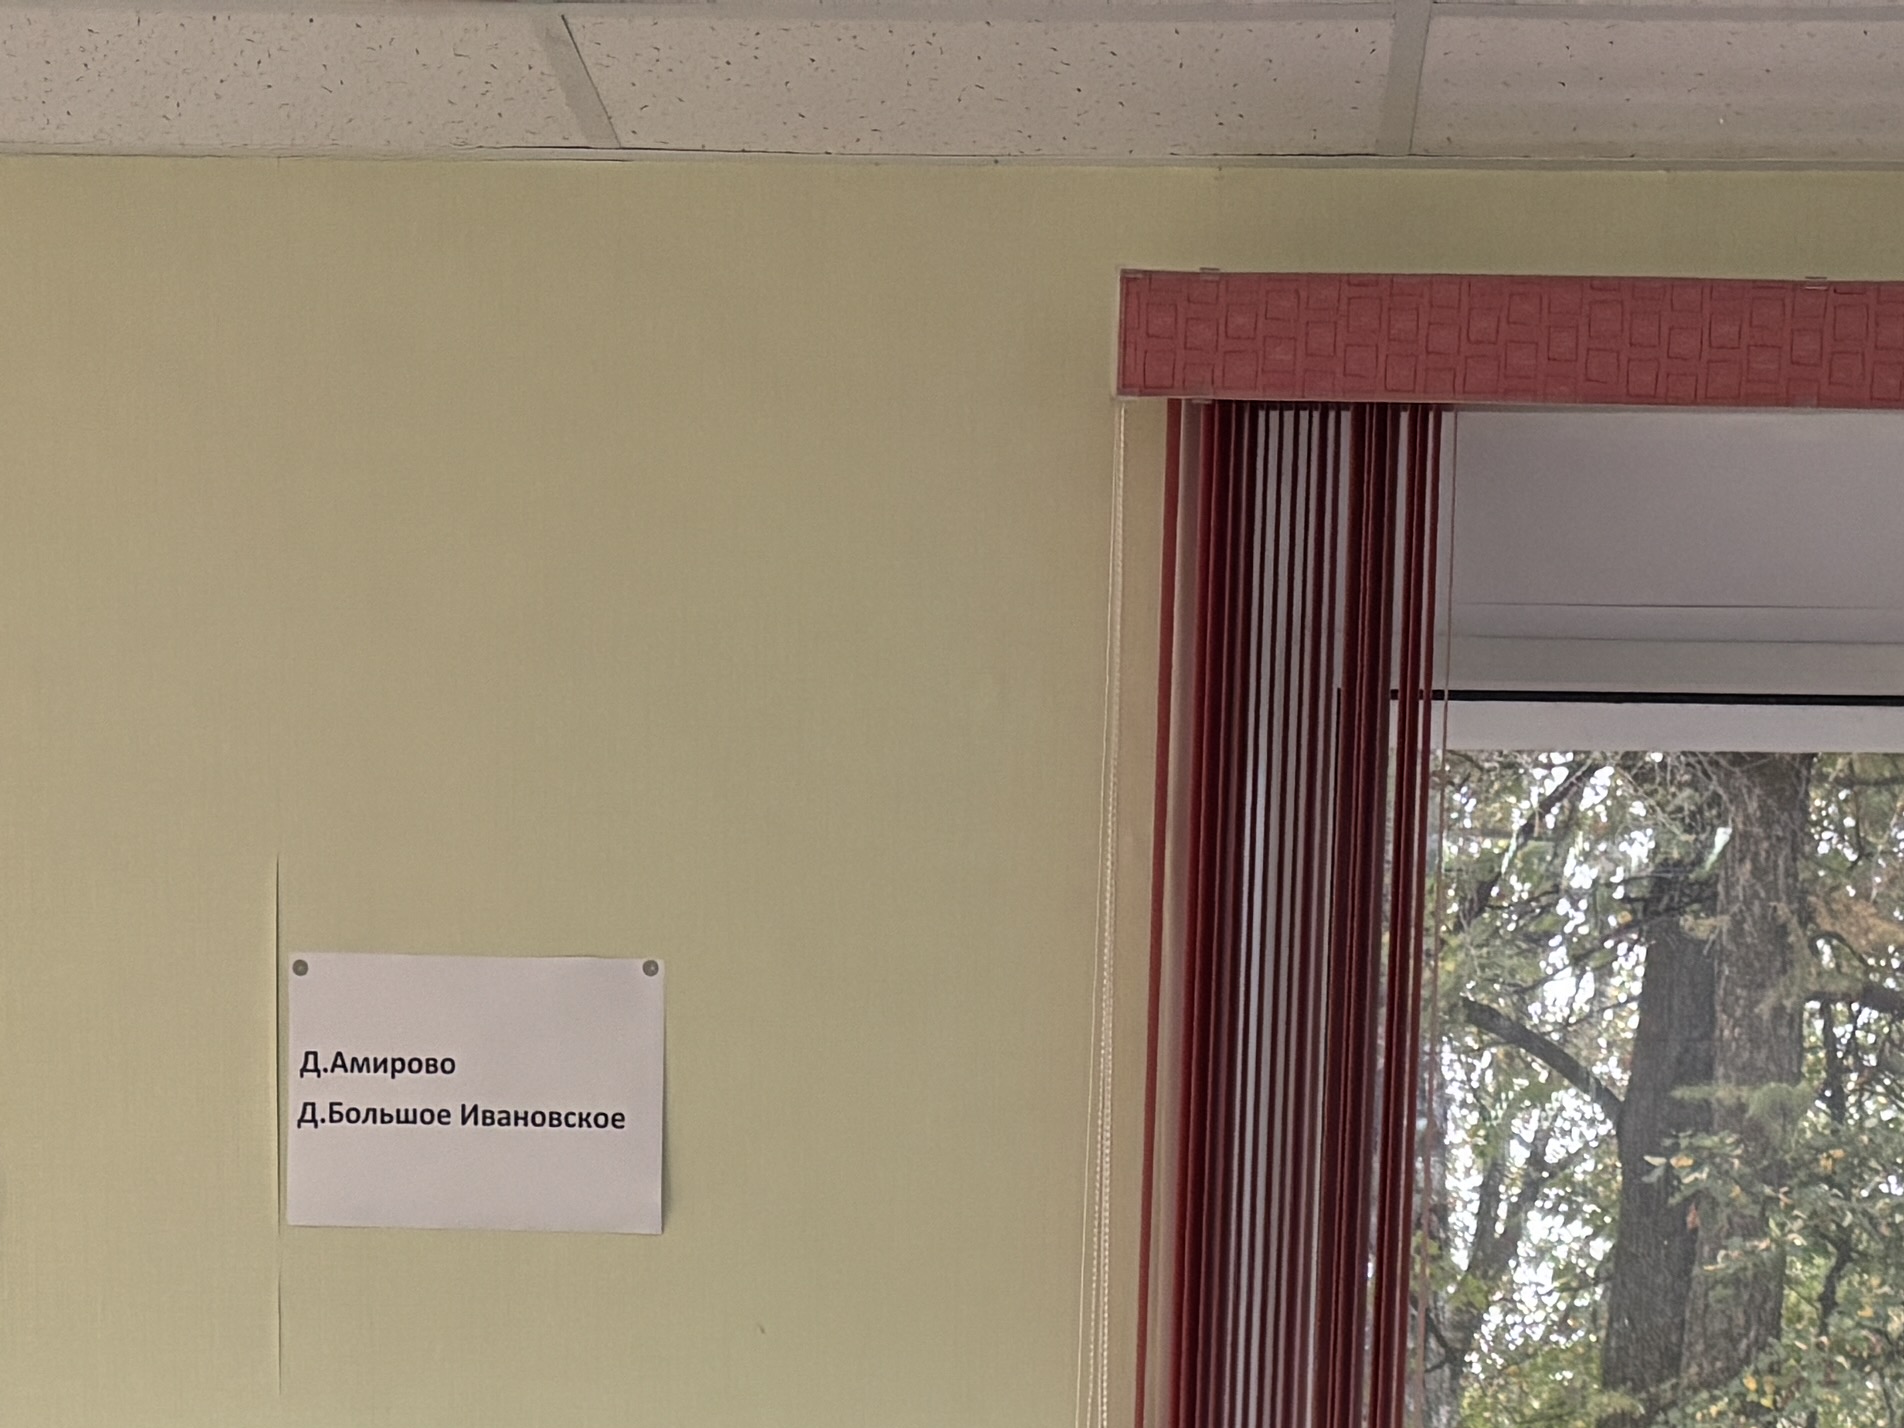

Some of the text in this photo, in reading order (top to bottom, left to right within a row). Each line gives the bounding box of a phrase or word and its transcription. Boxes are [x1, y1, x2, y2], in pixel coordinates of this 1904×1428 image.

[299, 1051, 456, 1078] Д.Амирово
[297, 1102, 626, 1129] Д.Большое Ивановское
